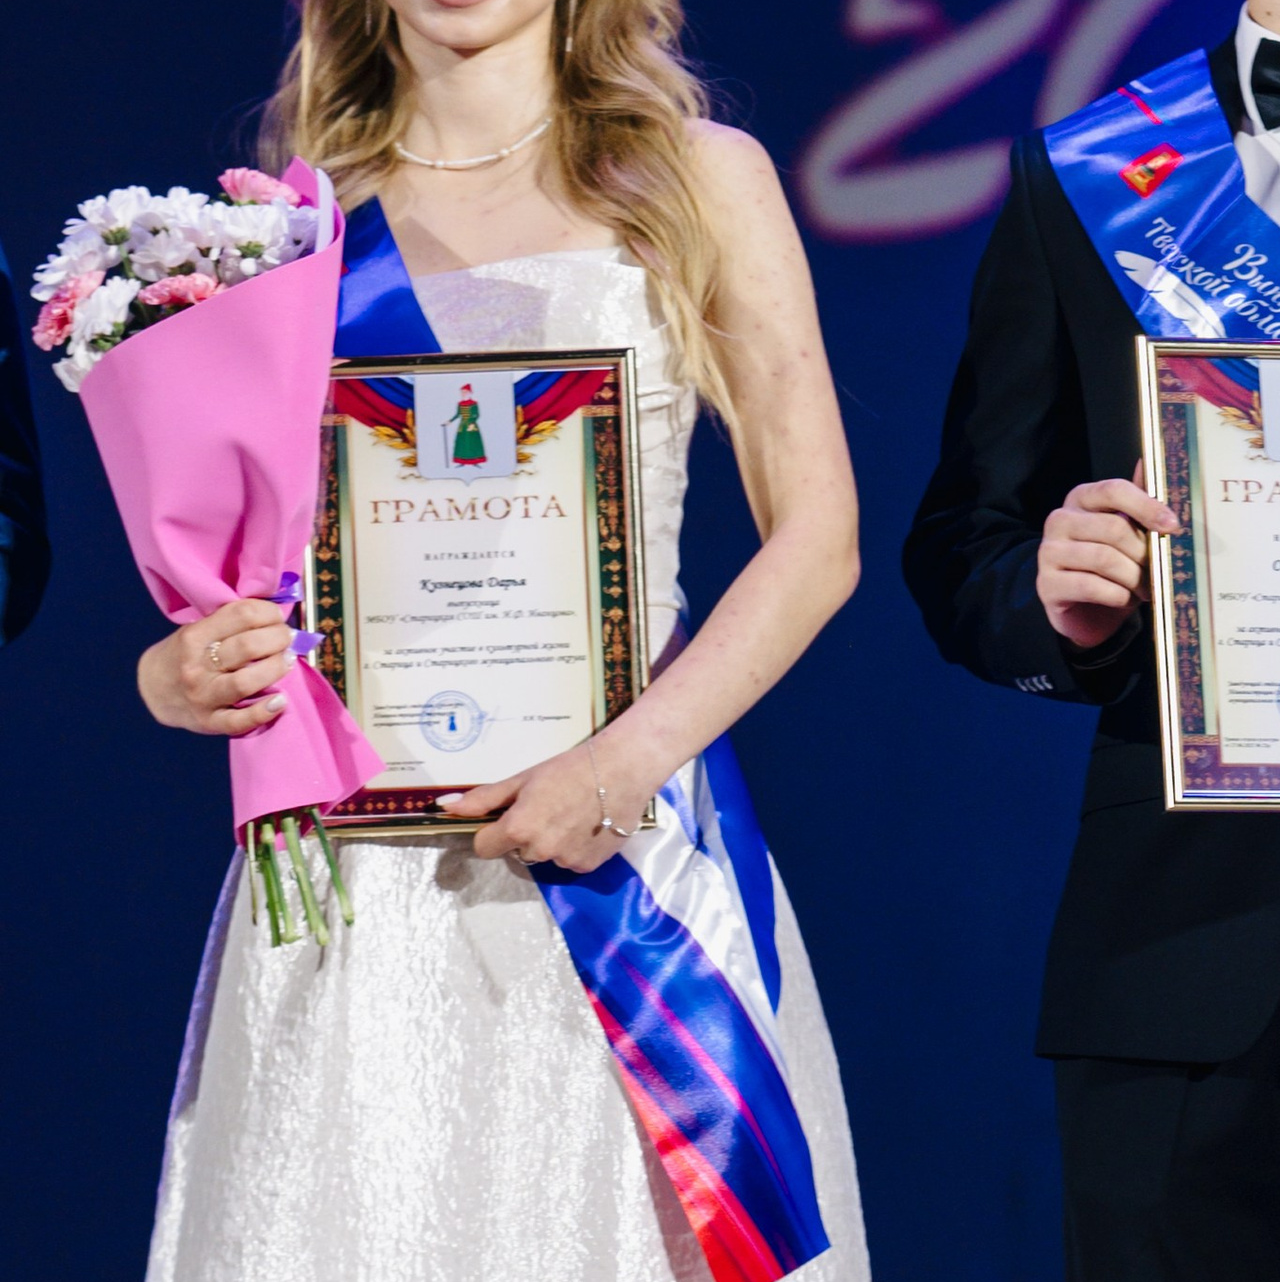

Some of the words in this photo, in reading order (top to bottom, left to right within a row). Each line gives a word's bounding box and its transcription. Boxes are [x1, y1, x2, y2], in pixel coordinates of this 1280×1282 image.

[369, 495, 568, 524] ГРАМОТА
[423, 549, 517, 562] НАГРАЖДАЕТСЯ
[419, 579, 483, 593] Кузнецова
[487, 576, 527, 591] Дарья
